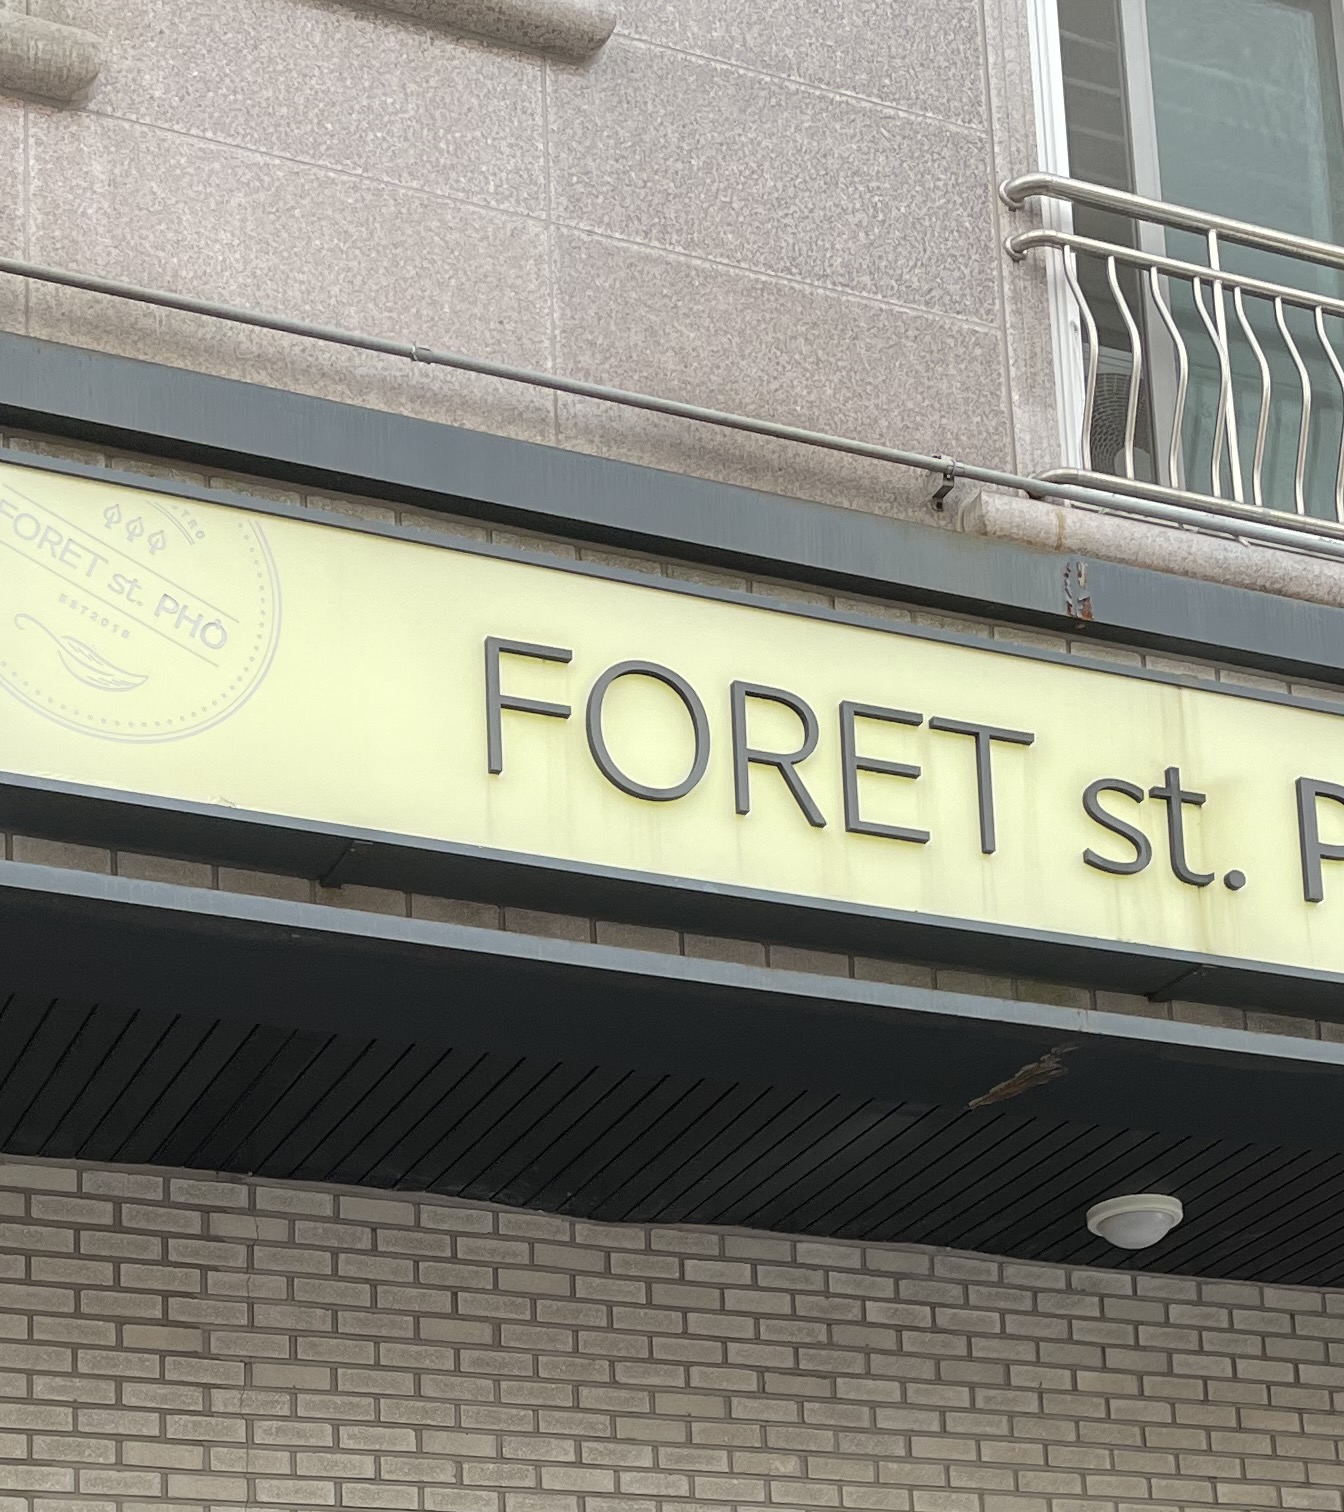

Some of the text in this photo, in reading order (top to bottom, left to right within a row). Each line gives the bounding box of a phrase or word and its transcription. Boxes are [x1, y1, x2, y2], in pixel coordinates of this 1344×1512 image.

[108, 573, 144, 607] st.
[484, 635, 1036, 855] FORET
[1081, 765, 1248, 890] st.
